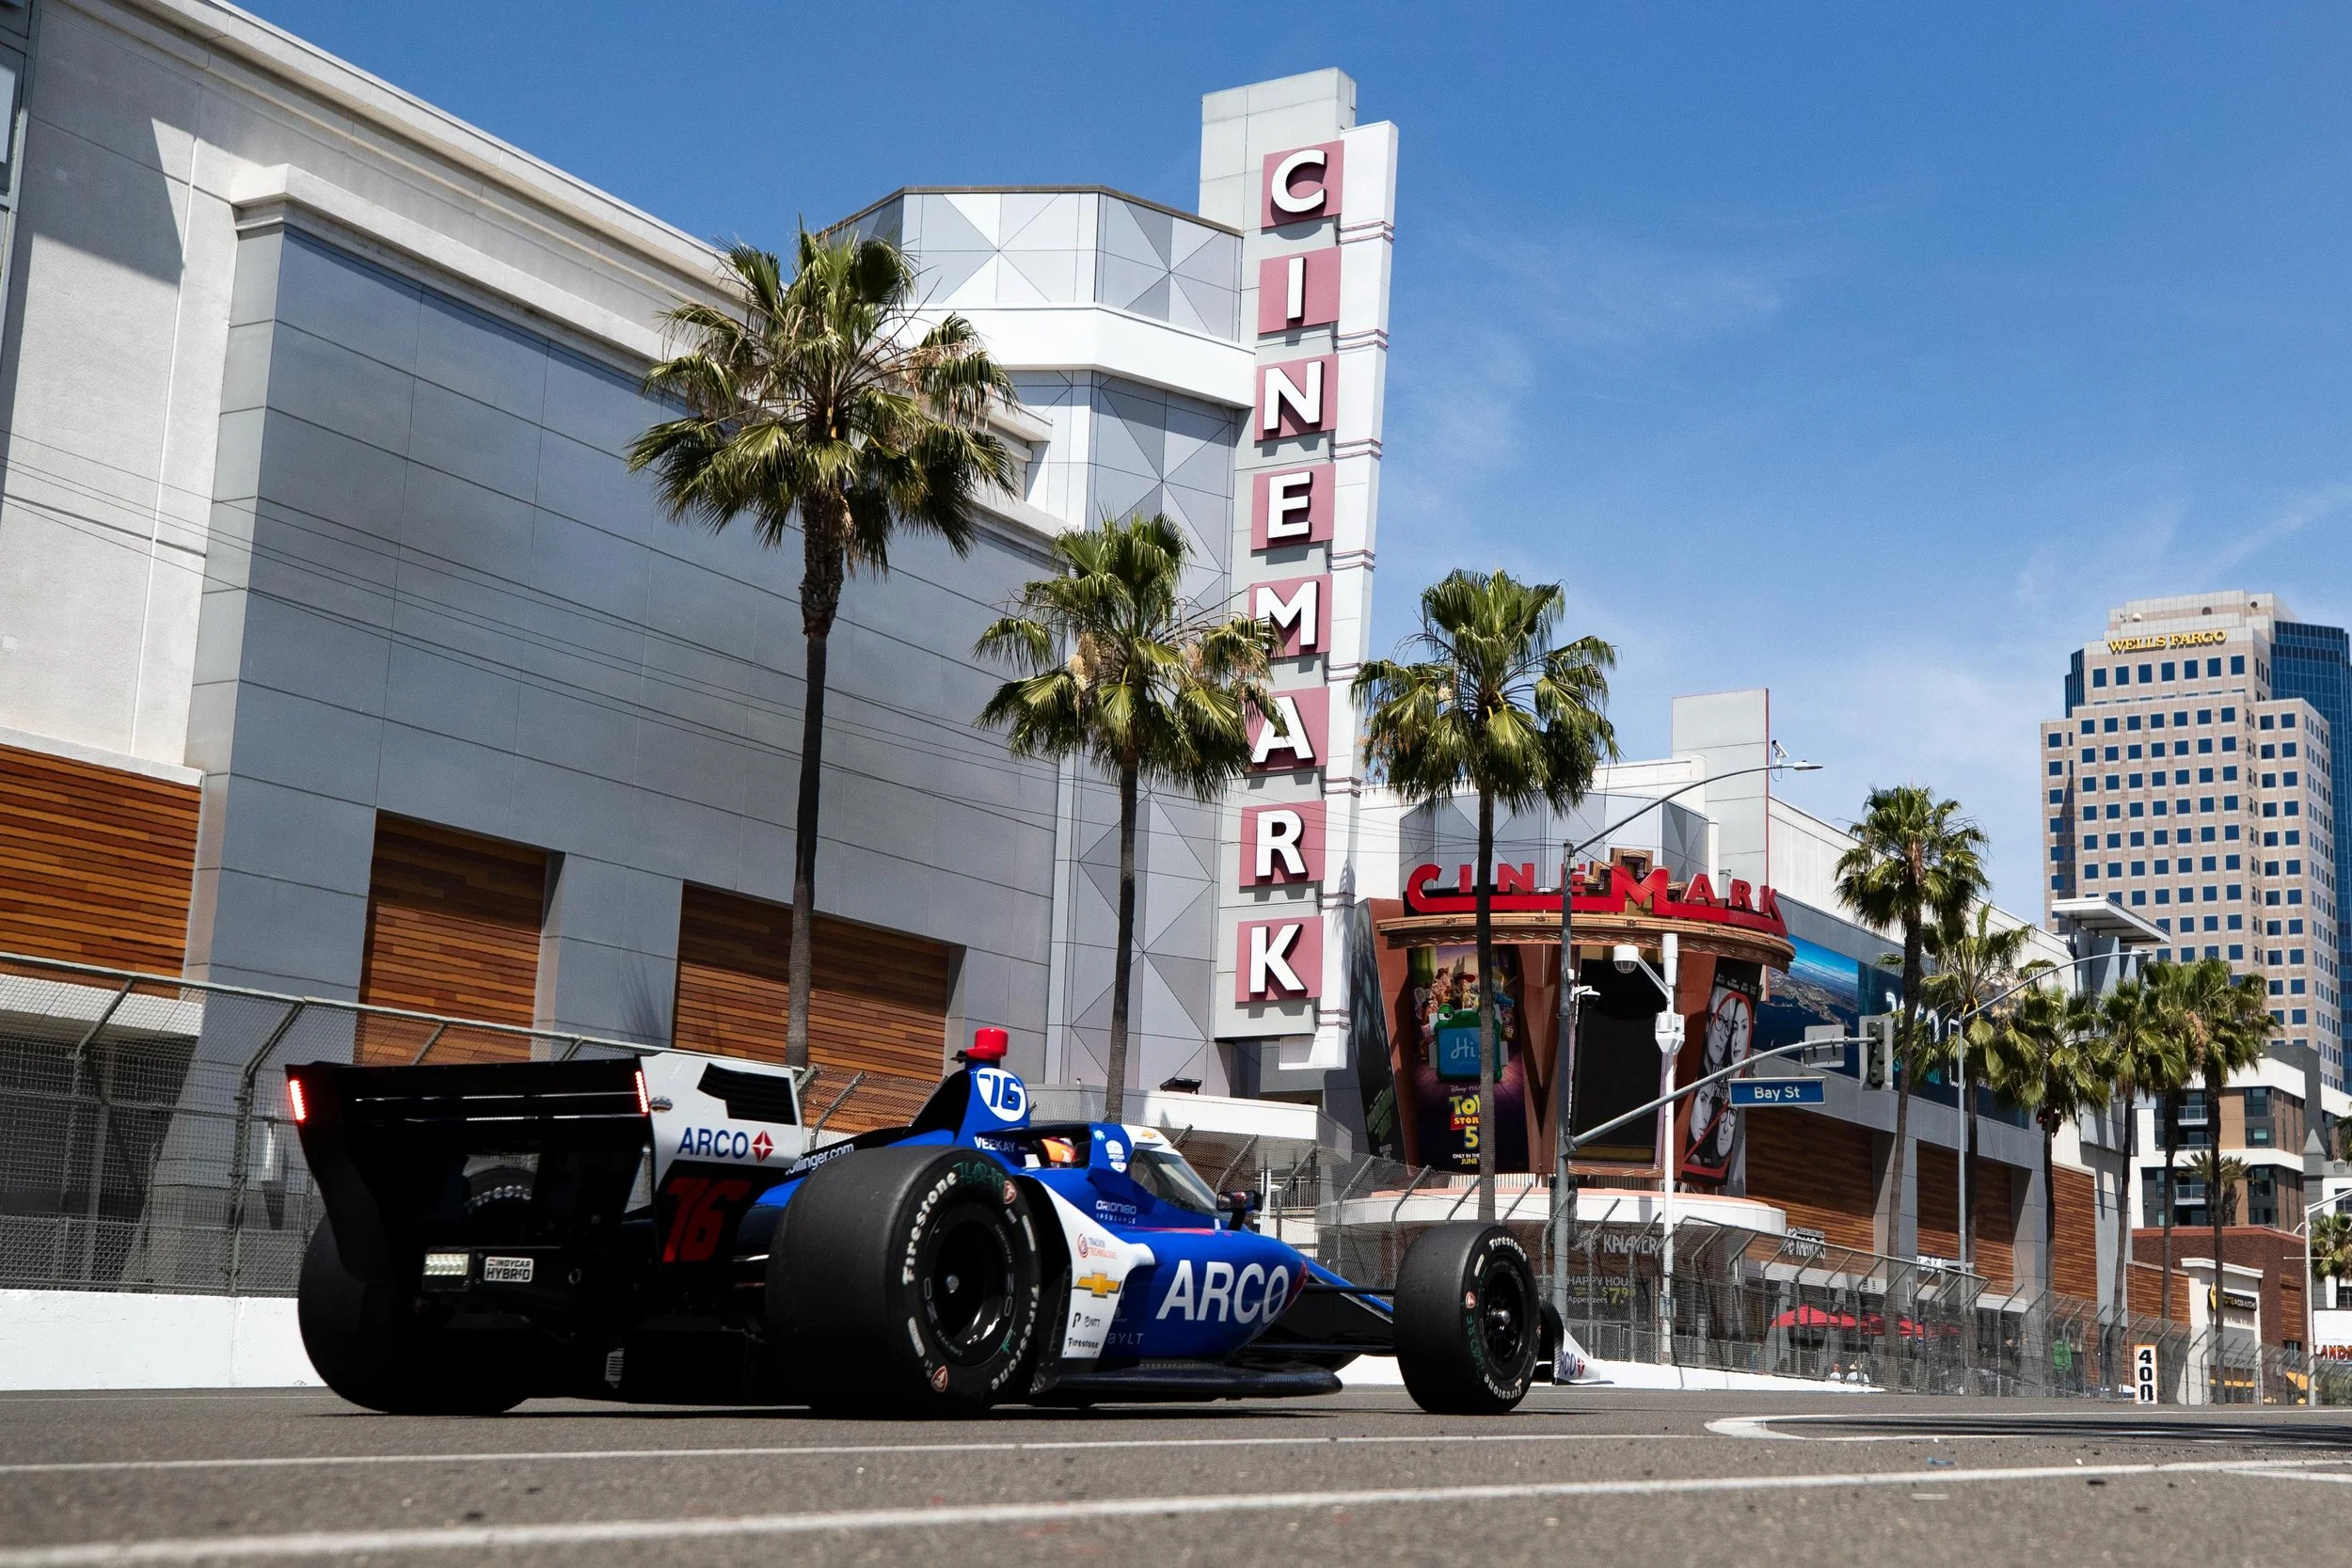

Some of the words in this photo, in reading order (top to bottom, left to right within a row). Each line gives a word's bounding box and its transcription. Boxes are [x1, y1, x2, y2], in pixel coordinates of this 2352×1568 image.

[1249, 150, 1327, 993] CINEMARK
[2108, 636, 2166, 653] WELLS
[2170, 629, 2228, 649] FARGO
[1406, 863, 1788, 938] CINEMARK
[979, 1073, 1022, 1111] 76
[1755, 1086, 1780, 1101] Bay
[1785, 1085, 1800, 1099] St
[1454, 1117, 1480, 1125] STOR
[677, 1127, 749, 1159] ARCO
[974, 1135, 1015, 1153] VEEKAY
[1464, 1126, 1479, 1148] 5
[786, 1143, 854, 1176] ollinger.com
[662, 1178, 751, 1262] 76
[902, 1172, 957, 1285] Firestone
[1488, 1236, 1528, 1261] Firestone
[1155, 1259, 1289, 1323] ARCO
[1567, 1275, 1603, 1286] HAPPY
[991, 1284, 1040, 1390] Firestone
[1068, 1338, 1099, 1350] Firestone
[1559, 1351, 1577, 1376] RCO
[1484, 1373, 1522, 1400] Firestone
